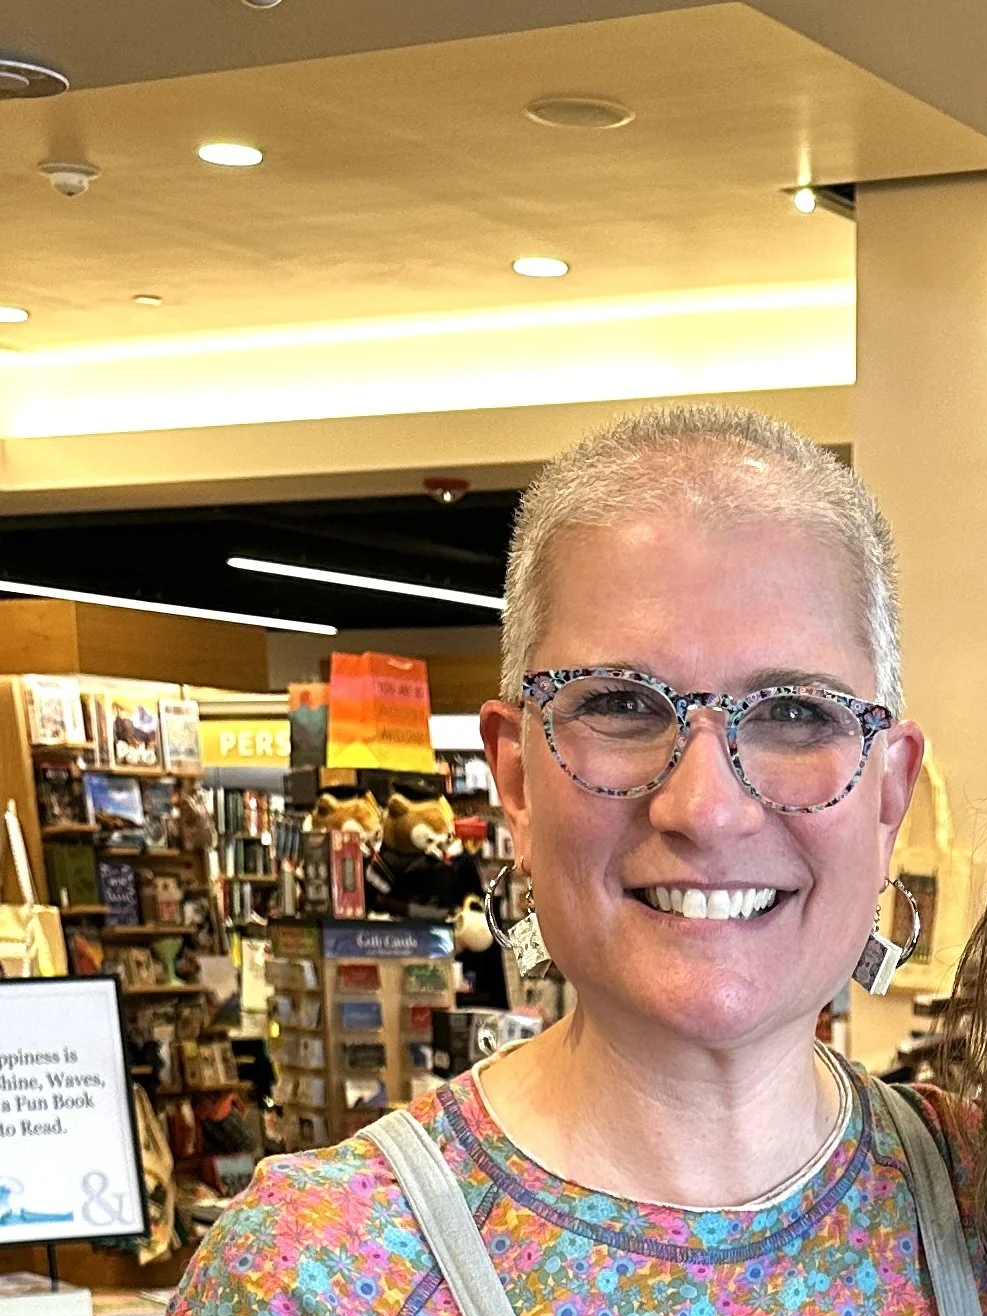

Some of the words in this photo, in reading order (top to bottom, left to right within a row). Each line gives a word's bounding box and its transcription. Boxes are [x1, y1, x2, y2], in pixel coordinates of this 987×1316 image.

[64, 1046, 78, 1064] is
[46, 1072, 106, 1089] Waves,
[15, 1095, 48, 1112] Fun
[53, 1092, 95, 1110] Book
[20, 1118, 67, 1136] Read.
